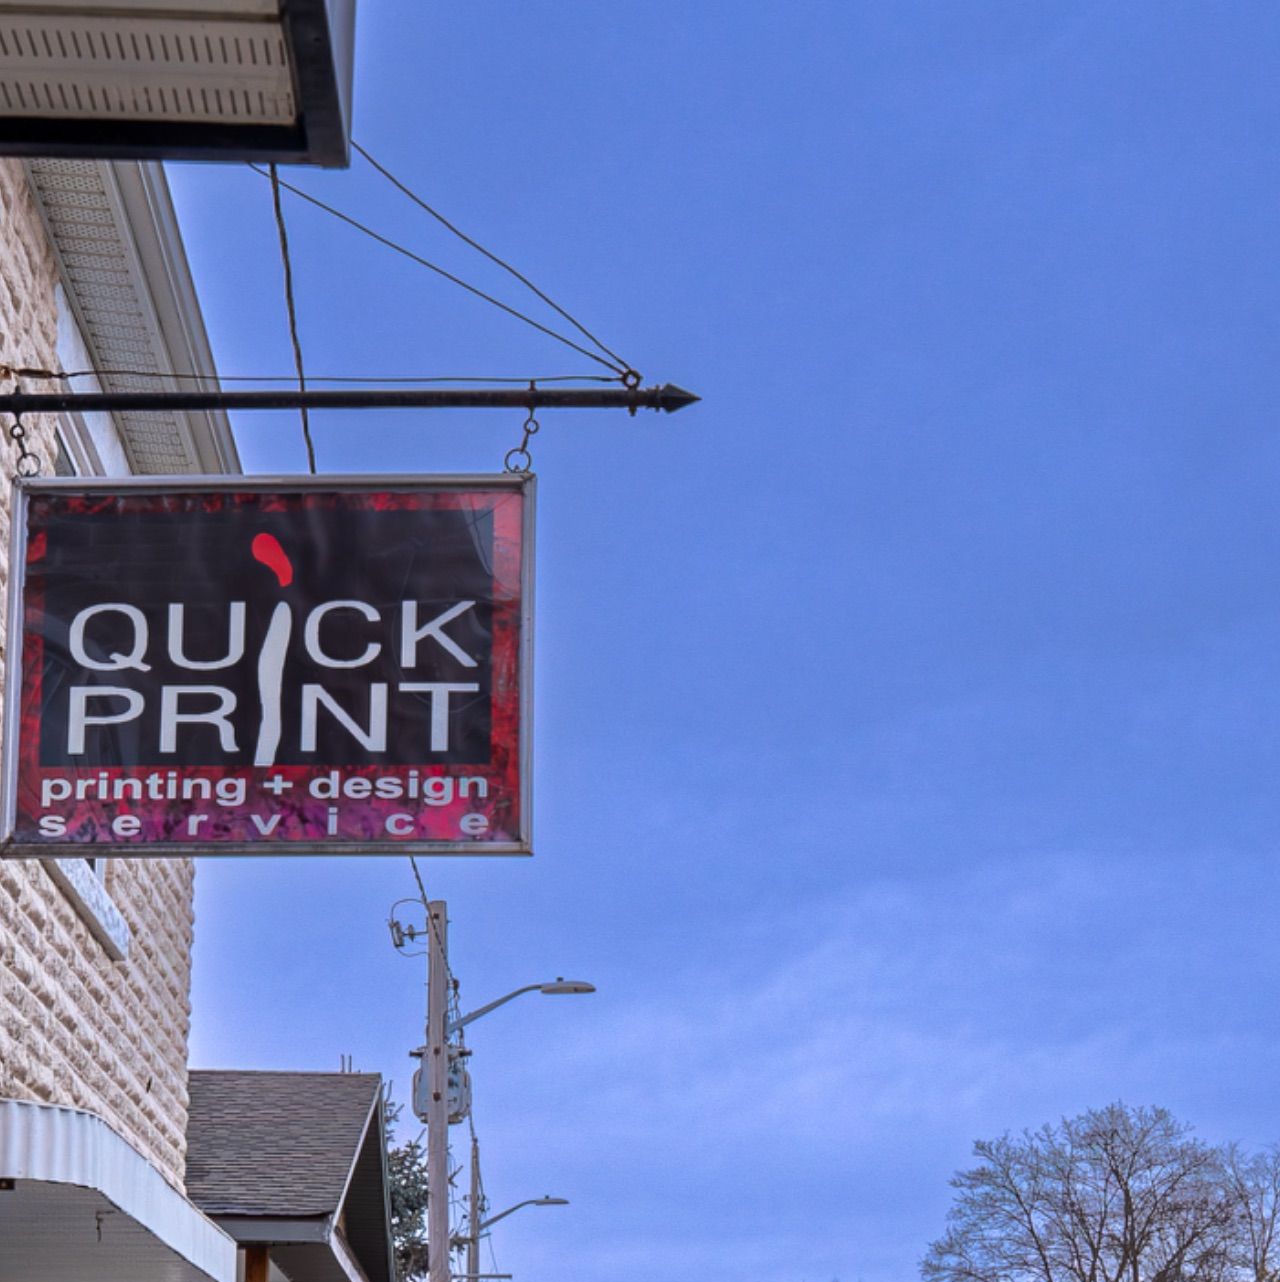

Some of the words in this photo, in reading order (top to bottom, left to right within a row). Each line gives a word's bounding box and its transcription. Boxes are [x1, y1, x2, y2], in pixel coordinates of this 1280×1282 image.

[68, 600, 477, 672] QUICK
[66, 682, 480, 767] PRINT
[41, 771, 247, 806] printing
[263, 773, 294, 796] +
[308, 770, 489, 805] design
[38, 808, 490, 837] service
